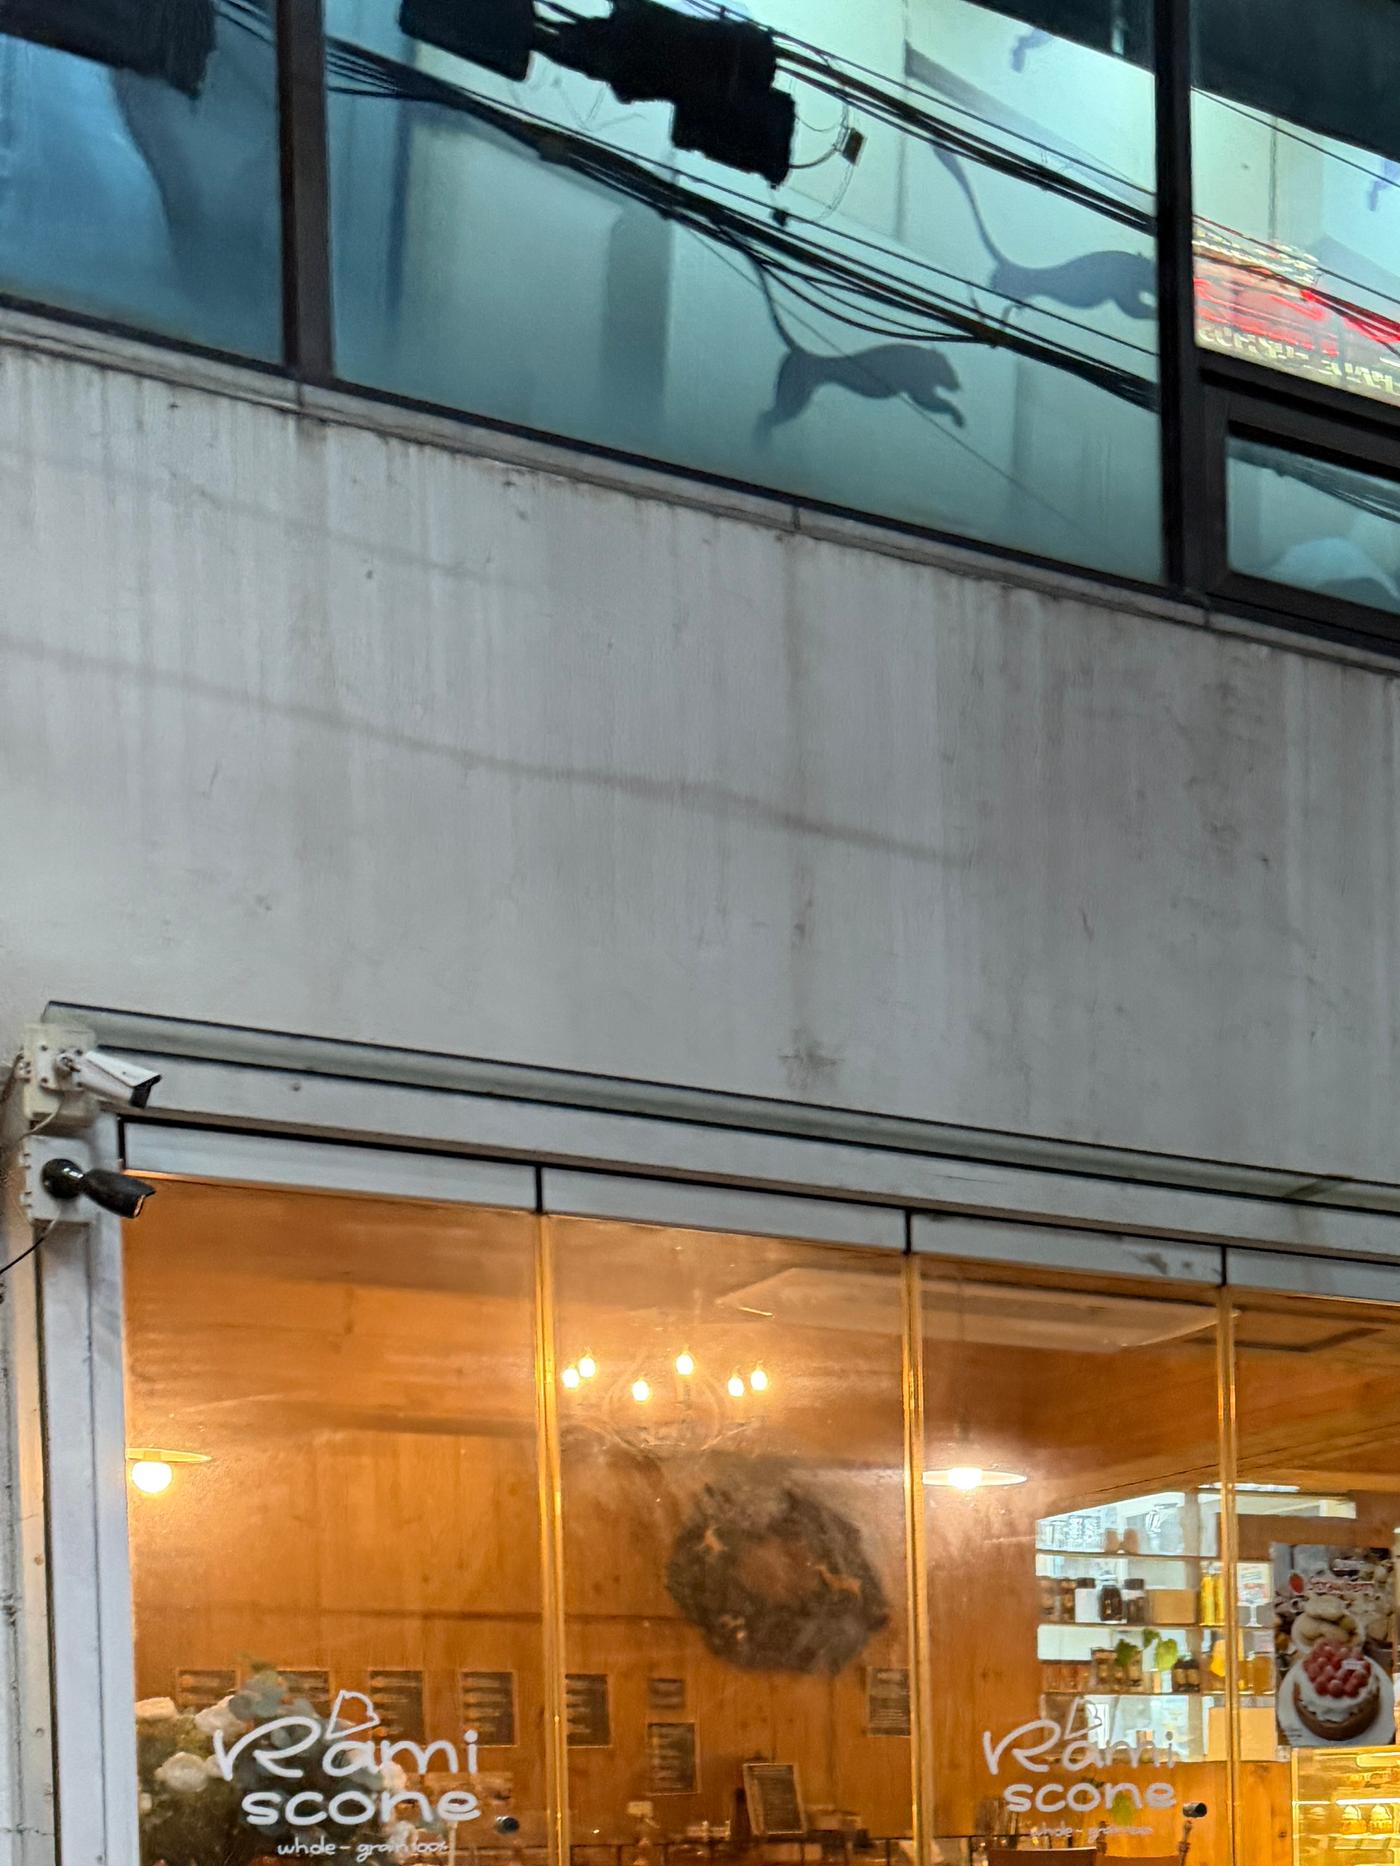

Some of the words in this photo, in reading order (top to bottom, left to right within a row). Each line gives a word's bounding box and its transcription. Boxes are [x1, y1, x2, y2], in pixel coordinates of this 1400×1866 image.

[213, 1716, 478, 1781] Rami
[982, 1719, 1175, 1775] Rami
[241, 1791, 481, 1826] scone
[1003, 1782, 1177, 1813] scone
